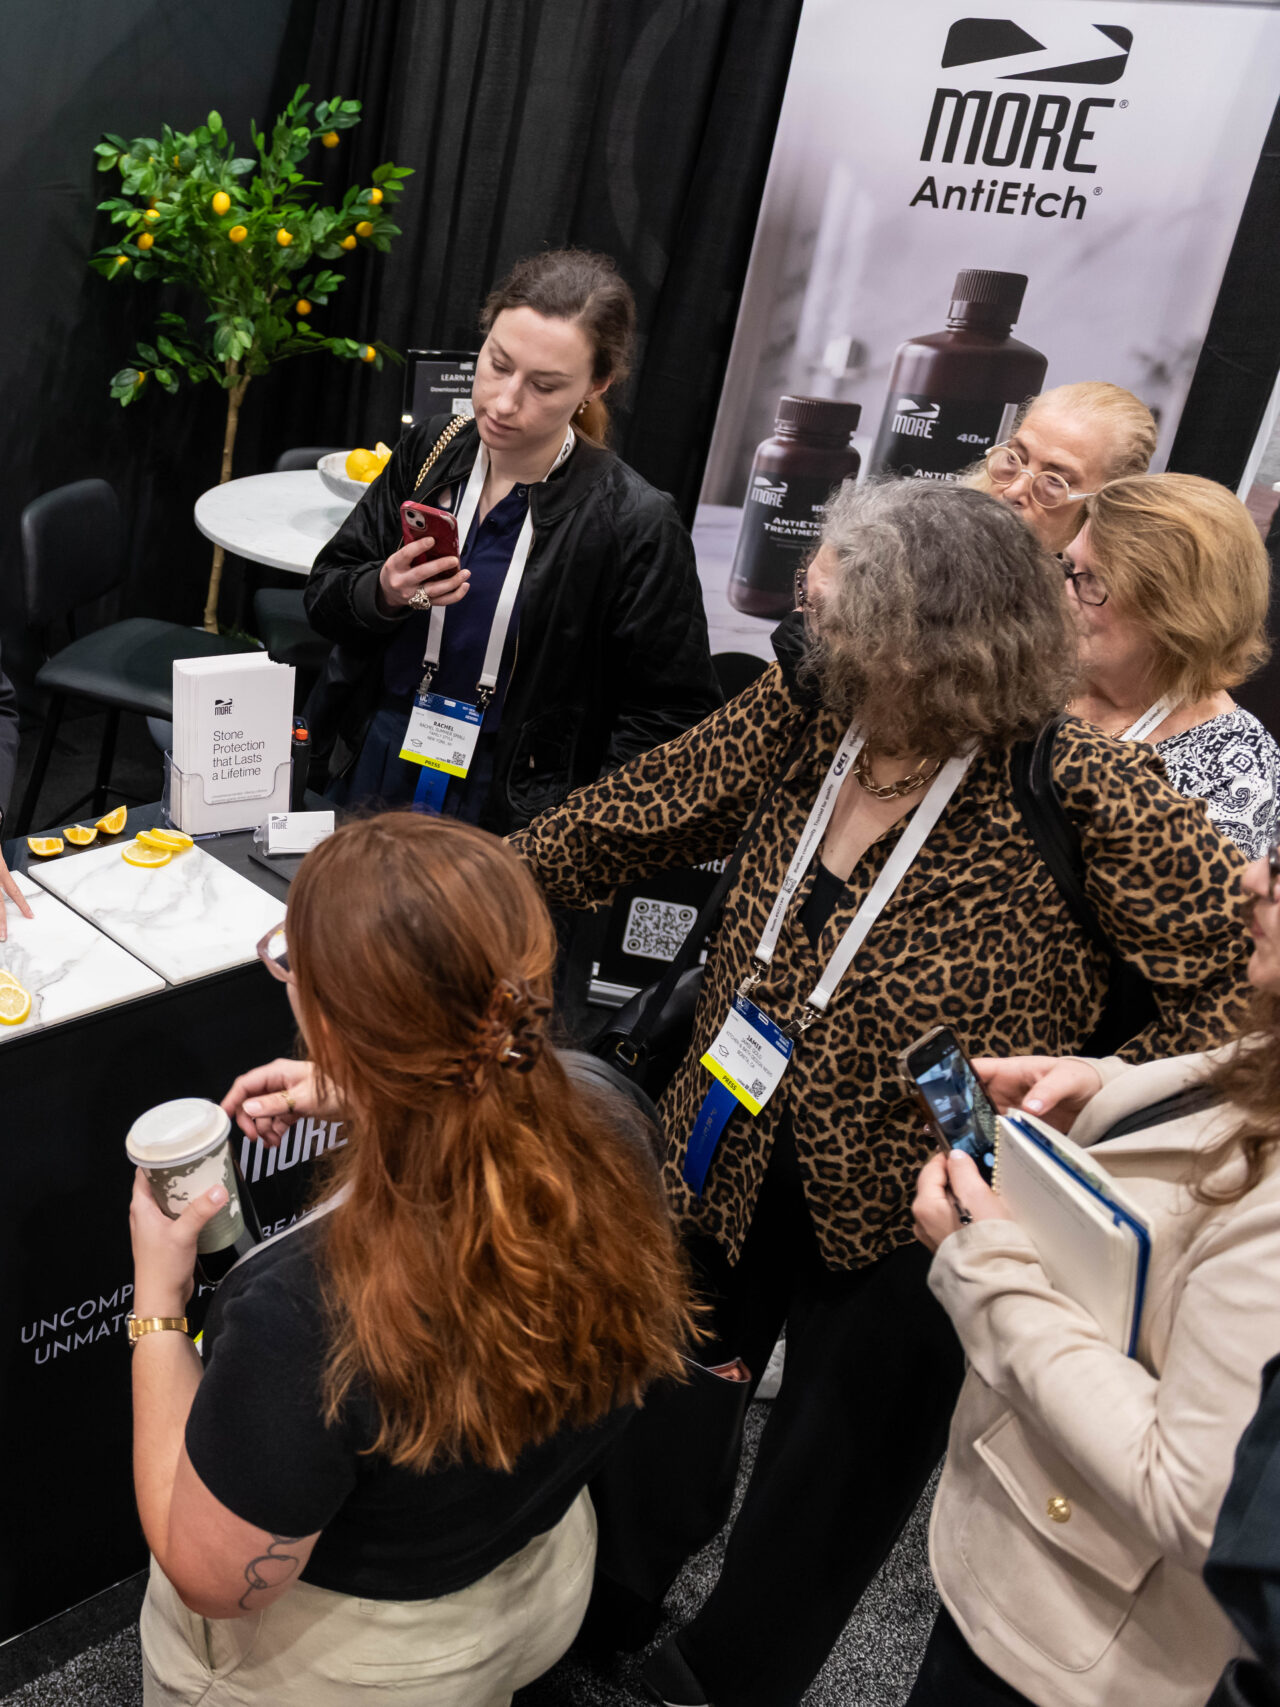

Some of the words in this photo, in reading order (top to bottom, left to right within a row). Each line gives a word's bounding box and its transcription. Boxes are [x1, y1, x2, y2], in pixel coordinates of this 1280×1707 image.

[920, 88, 1116, 174] MORE
[908, 176, 1087, 220] AntiEtch
[892, 414, 936, 439] MORE
[751, 487, 786, 508] MORE
[763, 522, 821, 538] TREATMEN
[214, 705, 233, 716] MORE
[433, 721, 454, 731] RACHEL
[213, 730, 244, 742] Stone
[213, 740, 265, 755] Protection
[212, 756, 233, 768] that
[234, 753, 263, 766] Lasts
[424, 759, 441, 769] PRESS
[212, 771, 219, 781] a
[220, 767, 261, 780] Lifetime
[746, 1034, 763, 1051] JAMIE
[722, 1075, 738, 1091] PRESS
